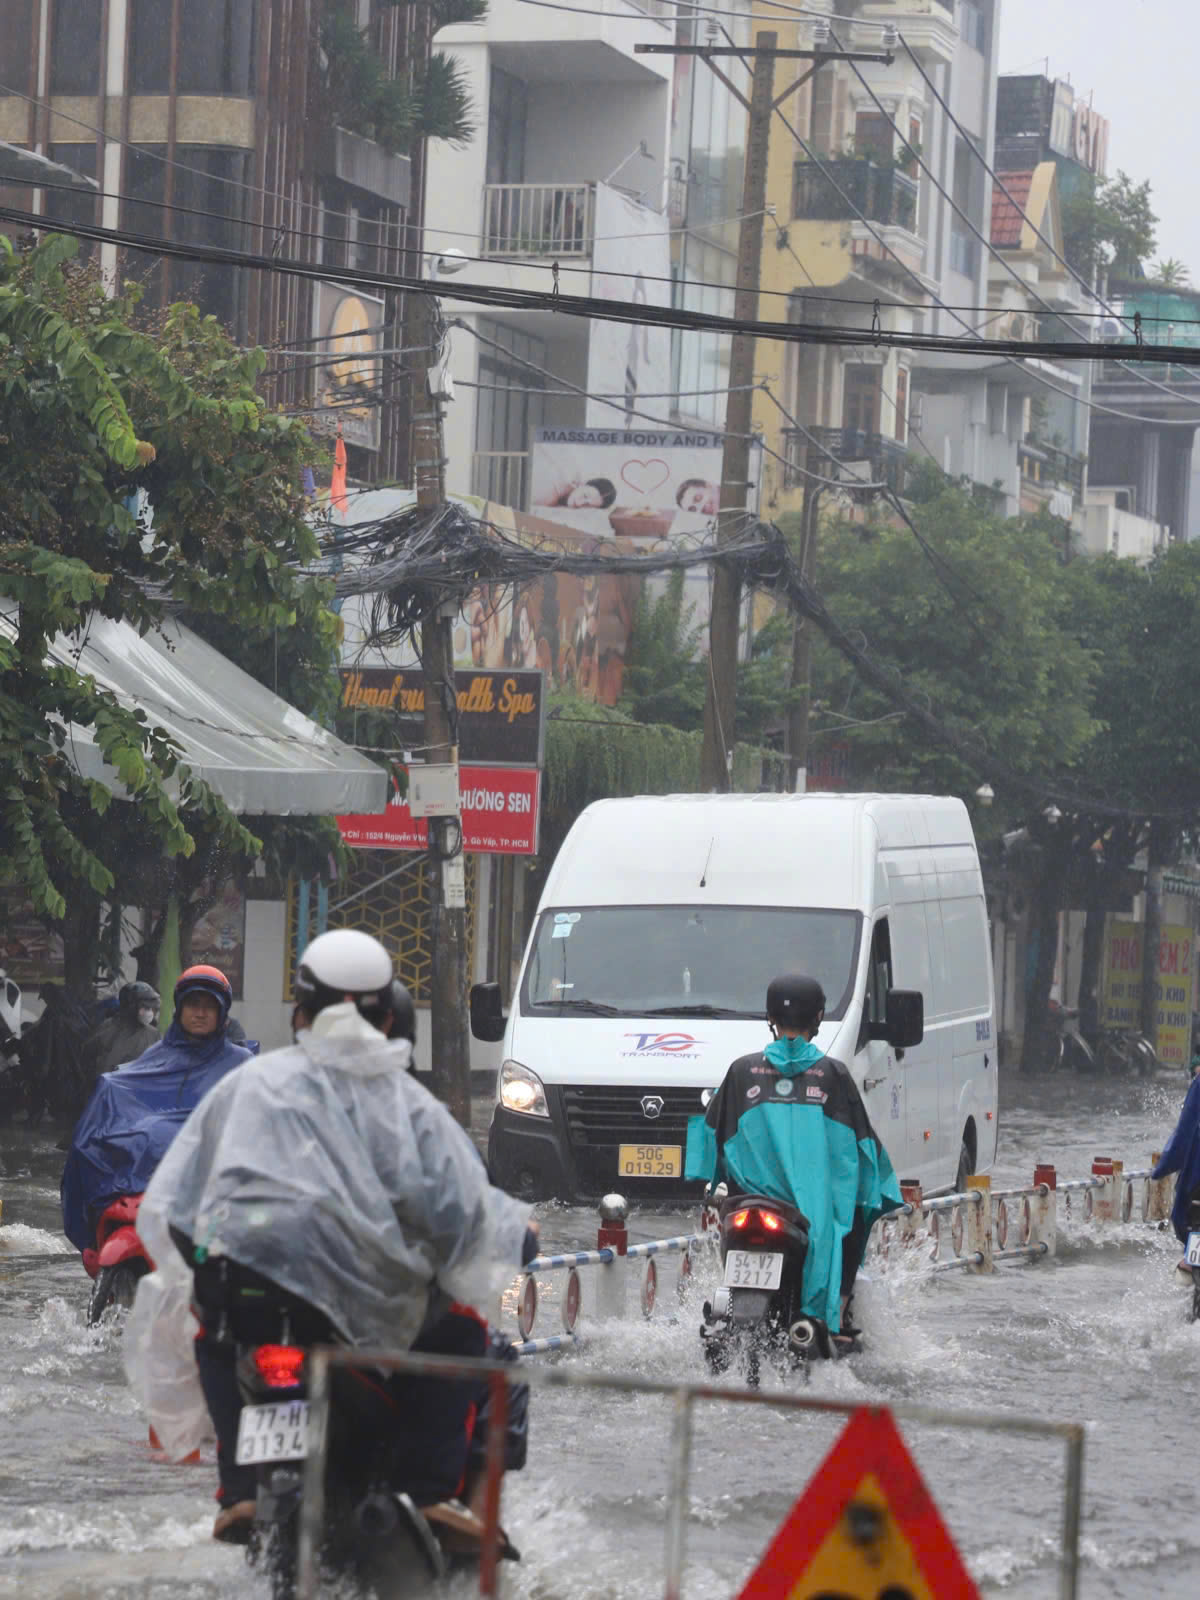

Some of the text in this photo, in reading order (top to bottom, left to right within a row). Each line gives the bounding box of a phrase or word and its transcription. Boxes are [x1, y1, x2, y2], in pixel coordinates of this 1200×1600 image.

[543, 431, 618, 443] MASSAGE
[623, 433, 668, 446] BODY
[672, 434, 709, 447] AND
[498, 679, 536, 724] Spa
[508, 791, 531, 813] SEN
[512, 839, 530, 849] HCM
[622, 1051, 702, 1059] TRANSPORT
[637, 1147, 663, 1160] 50G
[625, 1162, 674, 1175] 019.29
[736, 1253, 774, 1269] 54-V7
[733, 1270, 772, 1286] 3217
[241, 1431, 303, 1459] 313.4
